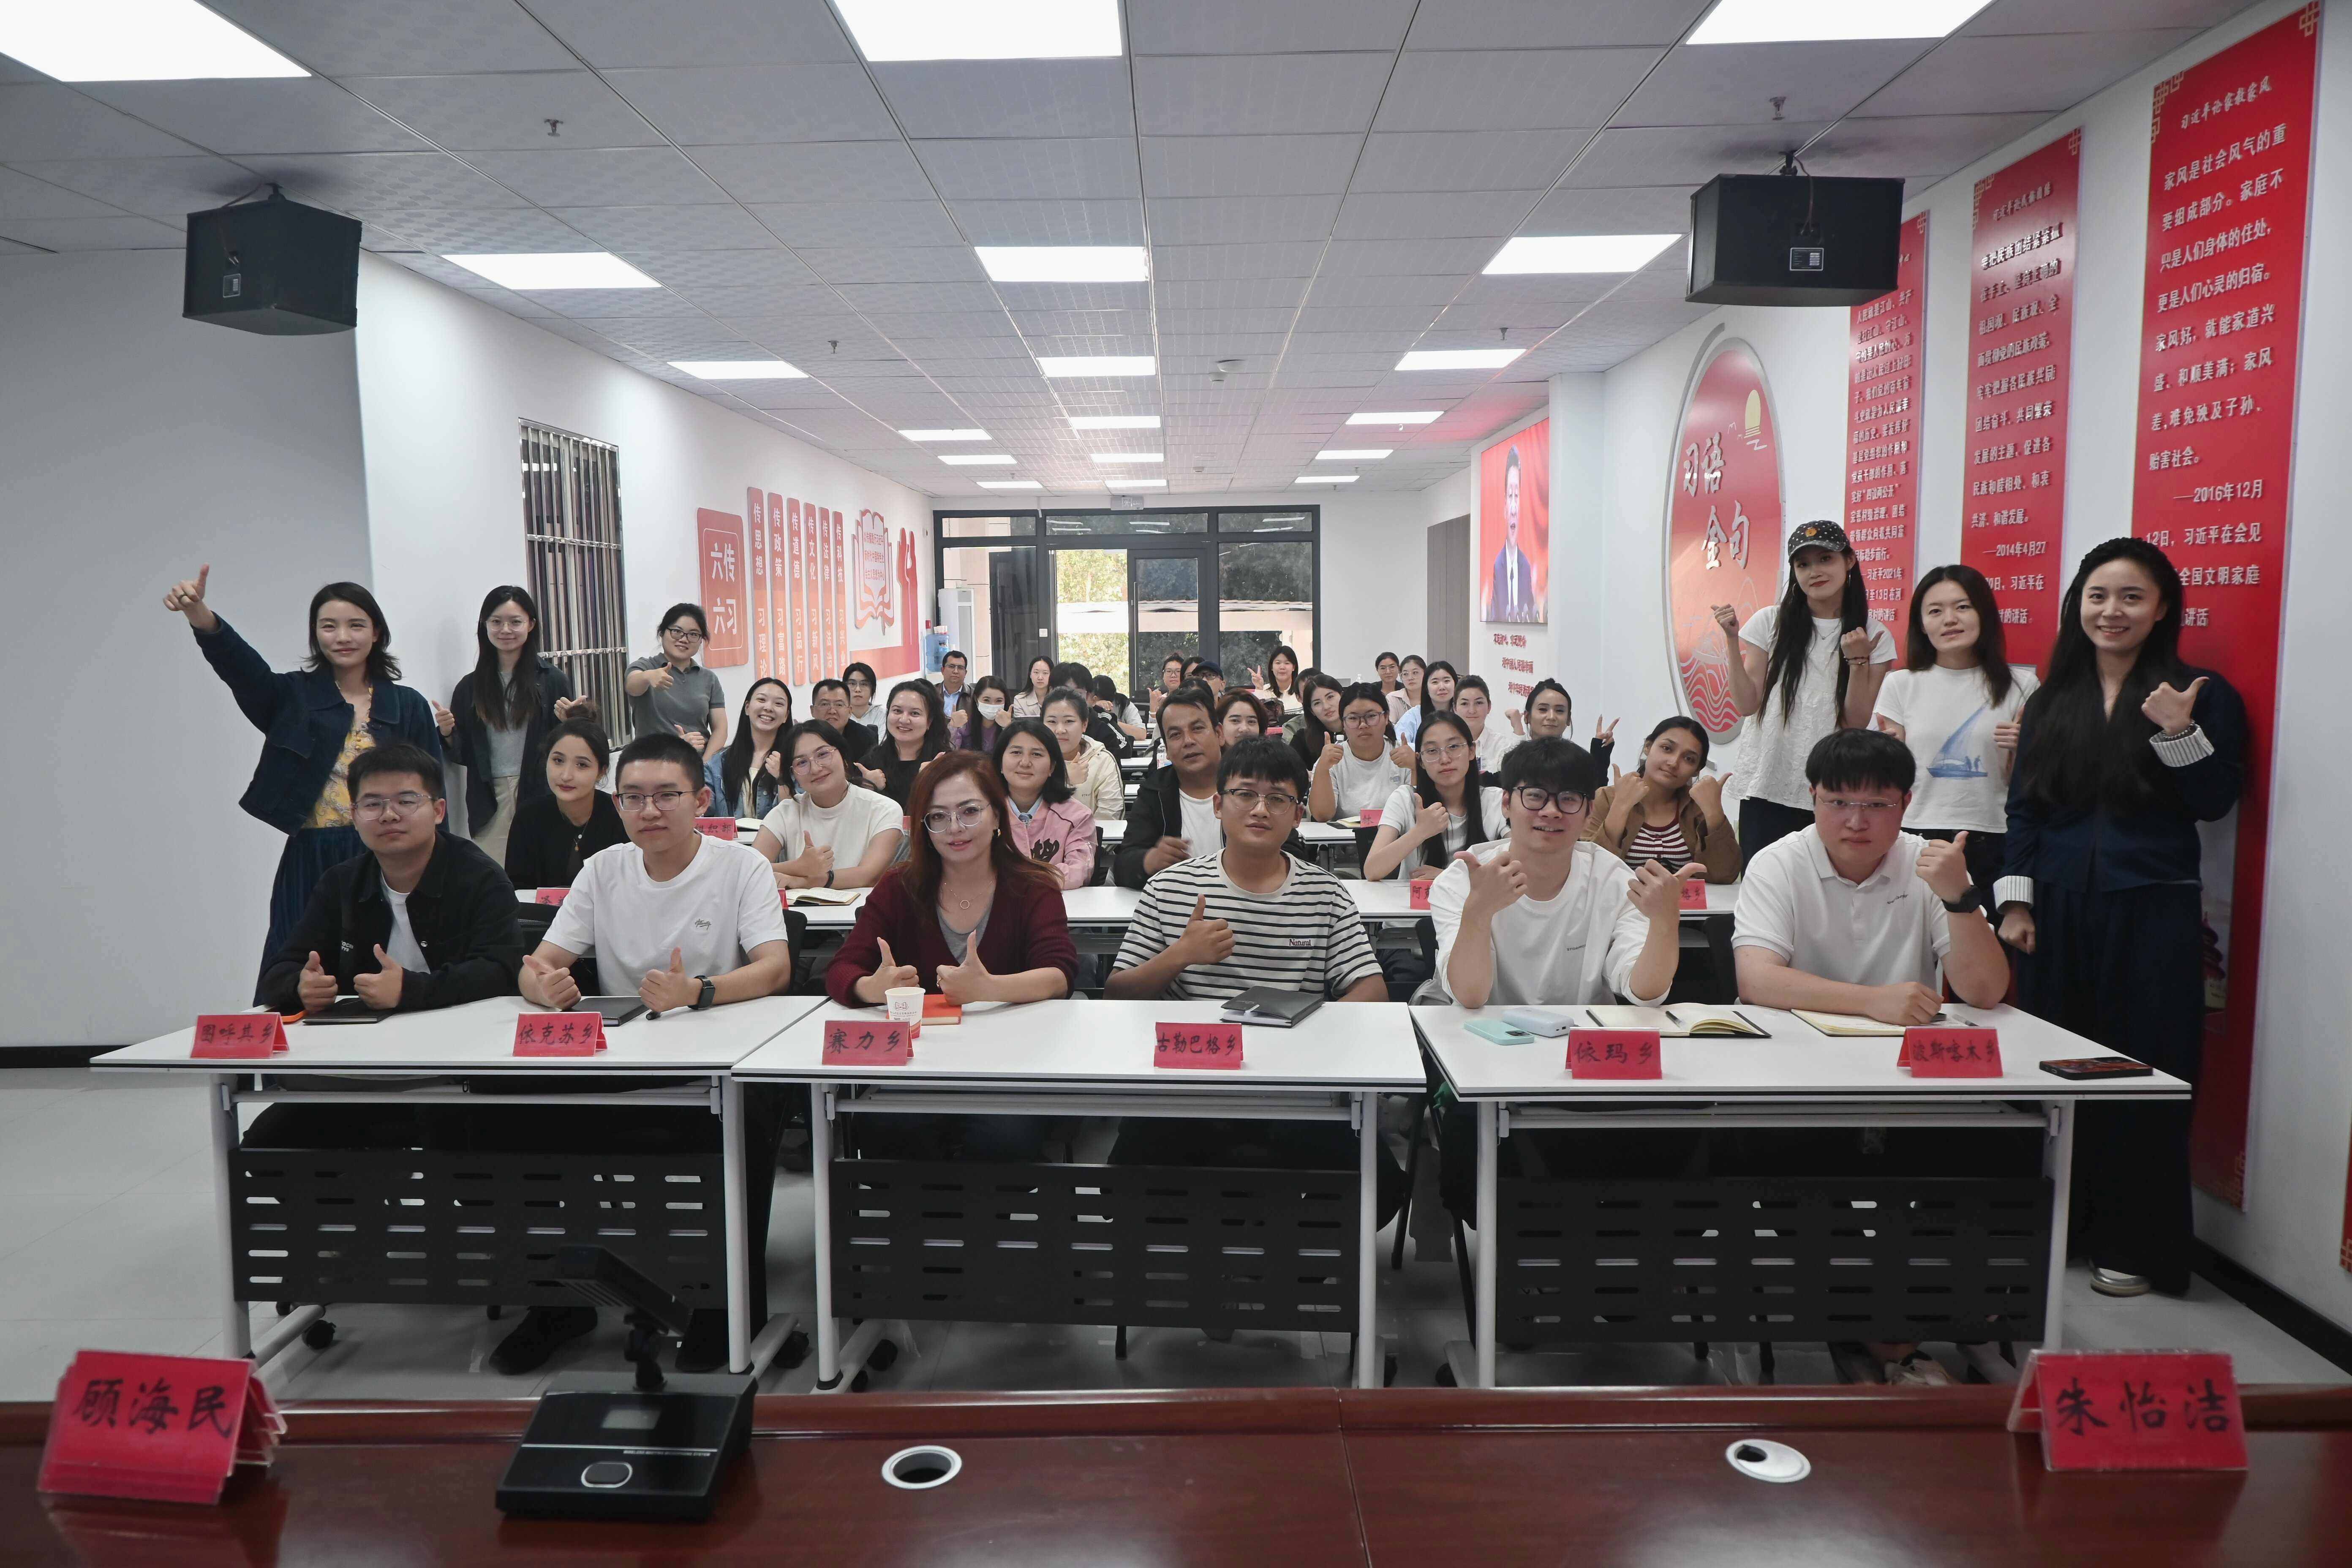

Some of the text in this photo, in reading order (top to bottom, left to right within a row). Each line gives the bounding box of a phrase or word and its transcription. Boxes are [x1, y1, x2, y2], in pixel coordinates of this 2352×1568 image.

[2164, 123, 2286, 191] 家风是社会风气的重
[2162, 169, 2284, 232] 要组成部分。家庭不
[2157, 263, 2270, 313] 更是人们心灵的归宿。
[2155, 303, 2276, 353] 家风好，就能家道兴
[2150, 446, 2200, 470] 贻害社会。
[754, 503, 763, 575] 传思想
[773, 508, 782, 577] 传政策
[1701, 500, 1750, 570] 金句
[710, 542, 735, 583] 六传
[2177, 564, 2260, 586] 全国文明家庭
[713, 597, 737, 635] 六习
[795, 608, 803, 672] 习品行
[2181, 607, 2209, 626] 讲话
[777, 608, 786, 676] 习富路
[518, 1022, 593, 1045] 依克苏乡
[1157, 1032, 1236, 1056] 古勒巴格乡
[1574, 1041, 1652, 1064] 依玛乡
[72, 1377, 237, 1440] 顾海民
[2056, 1377, 2230, 1436] 朱怡洁
